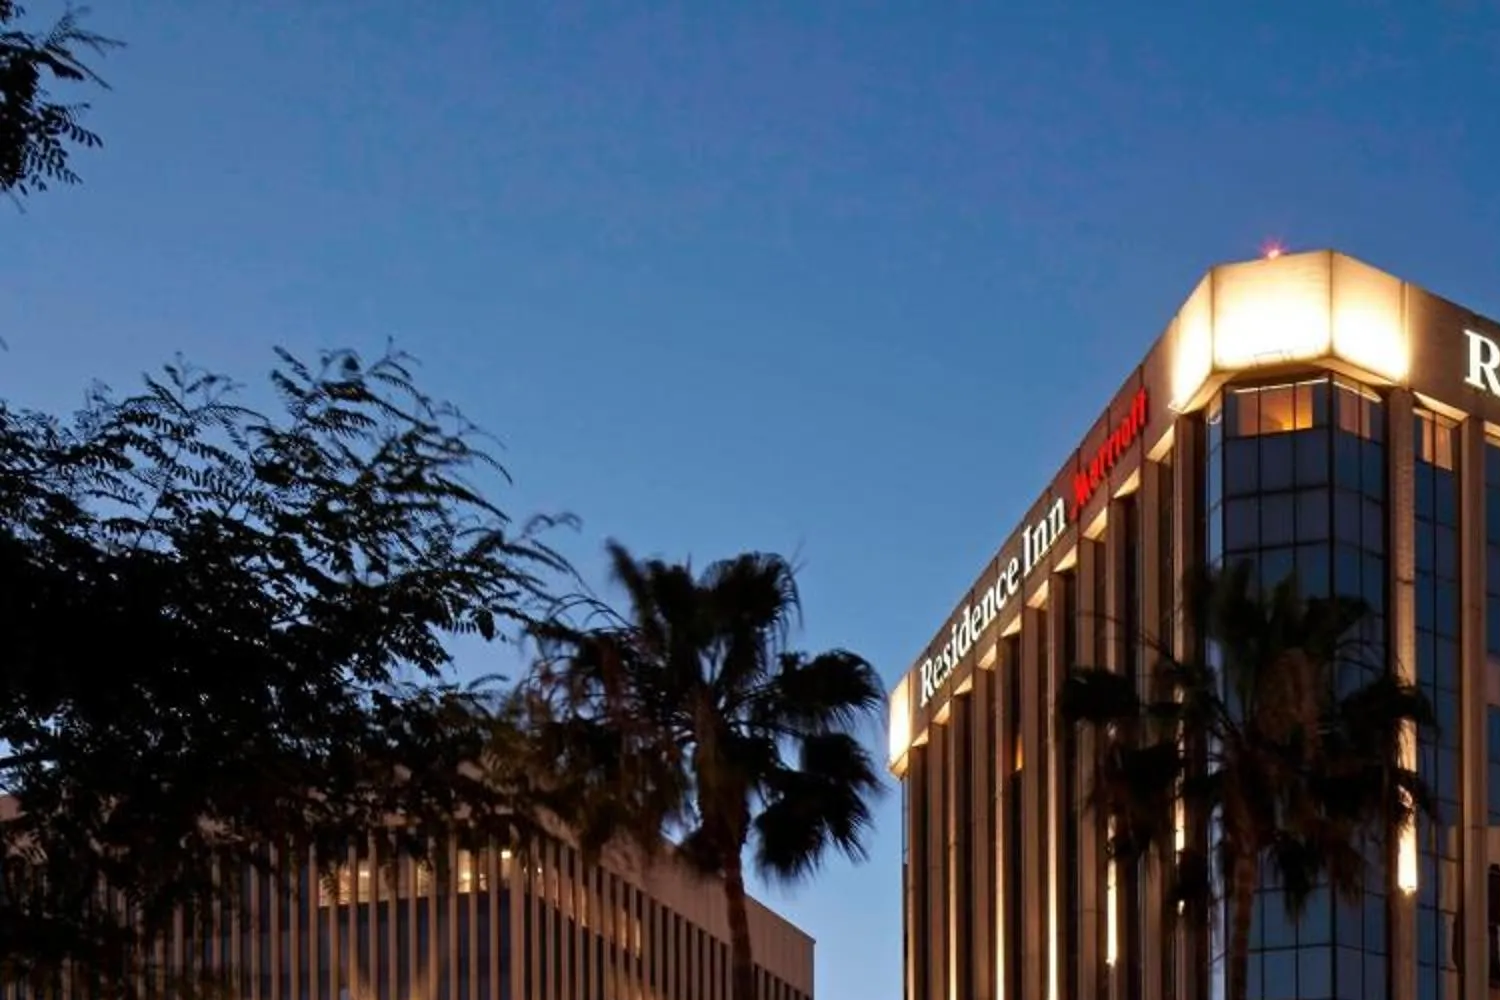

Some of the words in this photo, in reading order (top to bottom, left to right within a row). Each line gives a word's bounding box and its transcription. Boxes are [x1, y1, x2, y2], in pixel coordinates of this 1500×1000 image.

[919, 556, 1019, 706] Residence
[1022, 497, 1066, 577] Inn
[1069, 386, 1147, 520] Marriott
